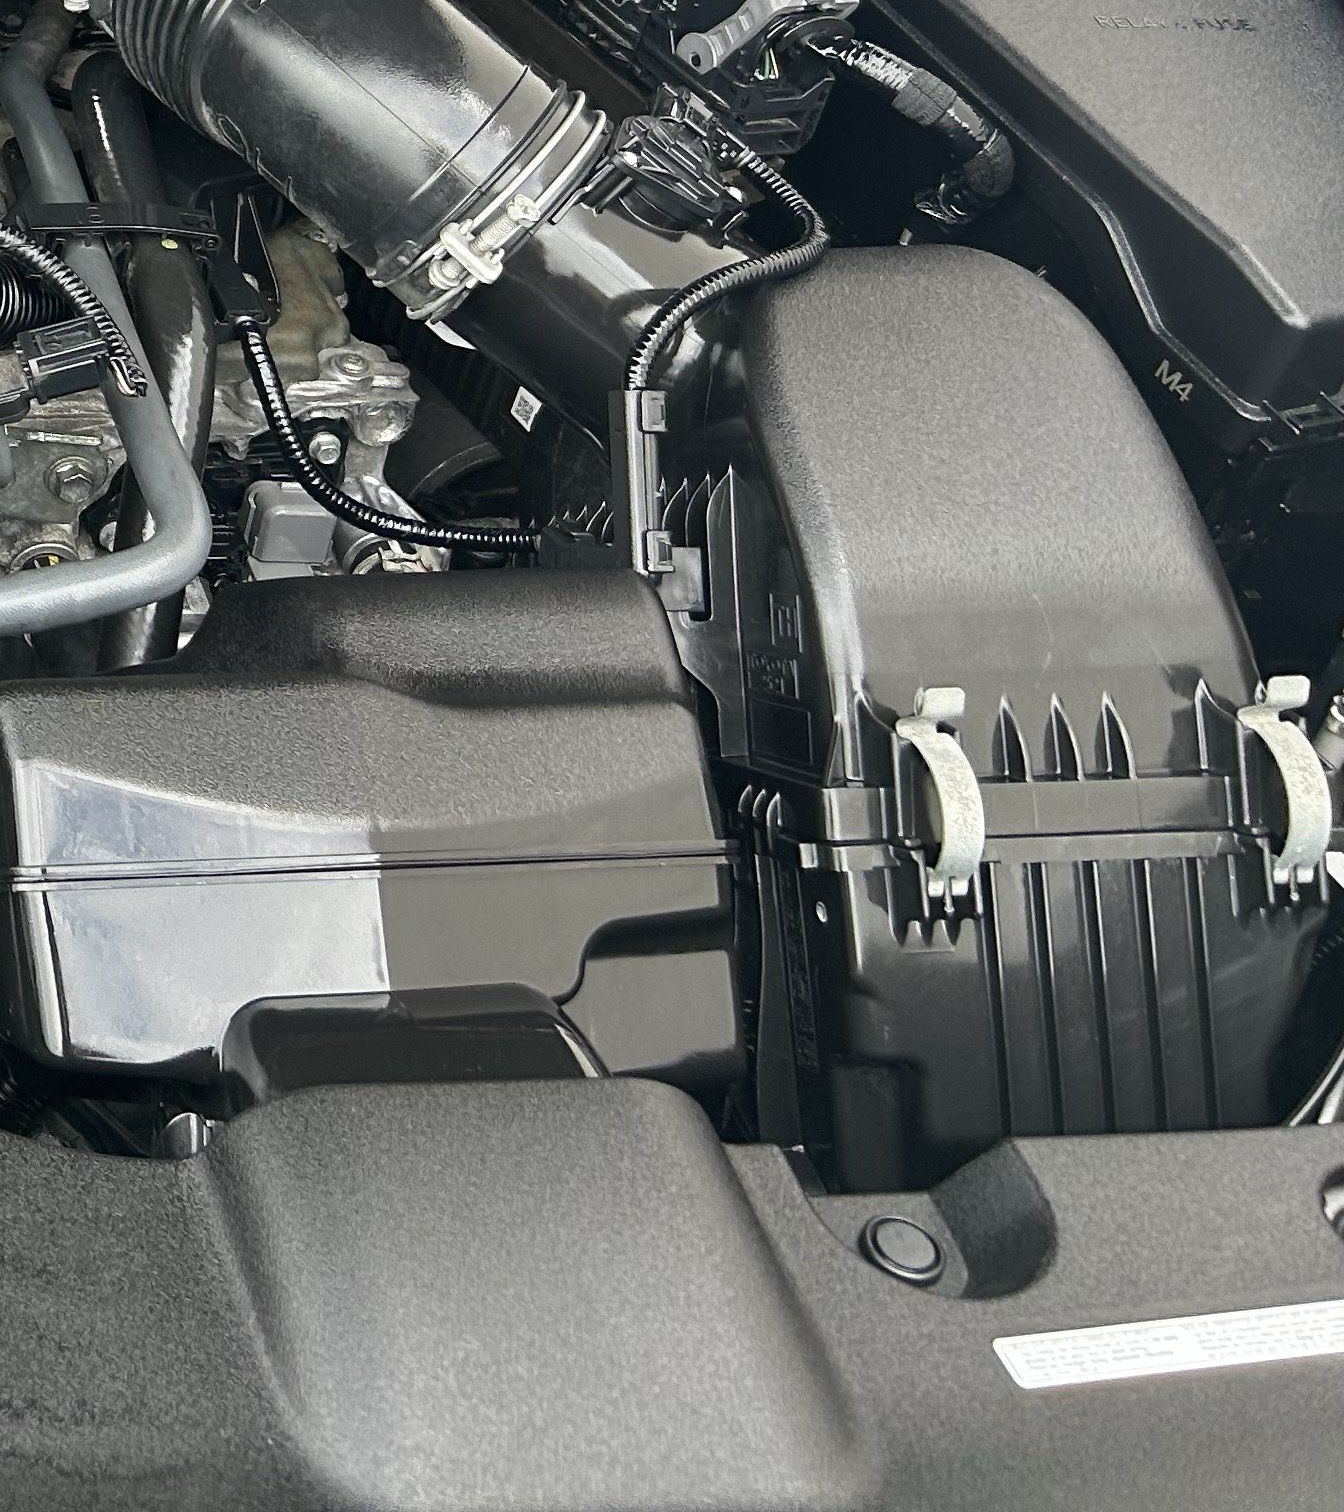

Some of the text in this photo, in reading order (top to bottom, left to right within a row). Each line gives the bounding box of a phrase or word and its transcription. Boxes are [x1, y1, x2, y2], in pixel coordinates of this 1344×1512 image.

[1094, 15, 1169, 31] RELAY
[1191, 18, 1258, 33] FUSE
[1154, 358, 1193, 402] M4
